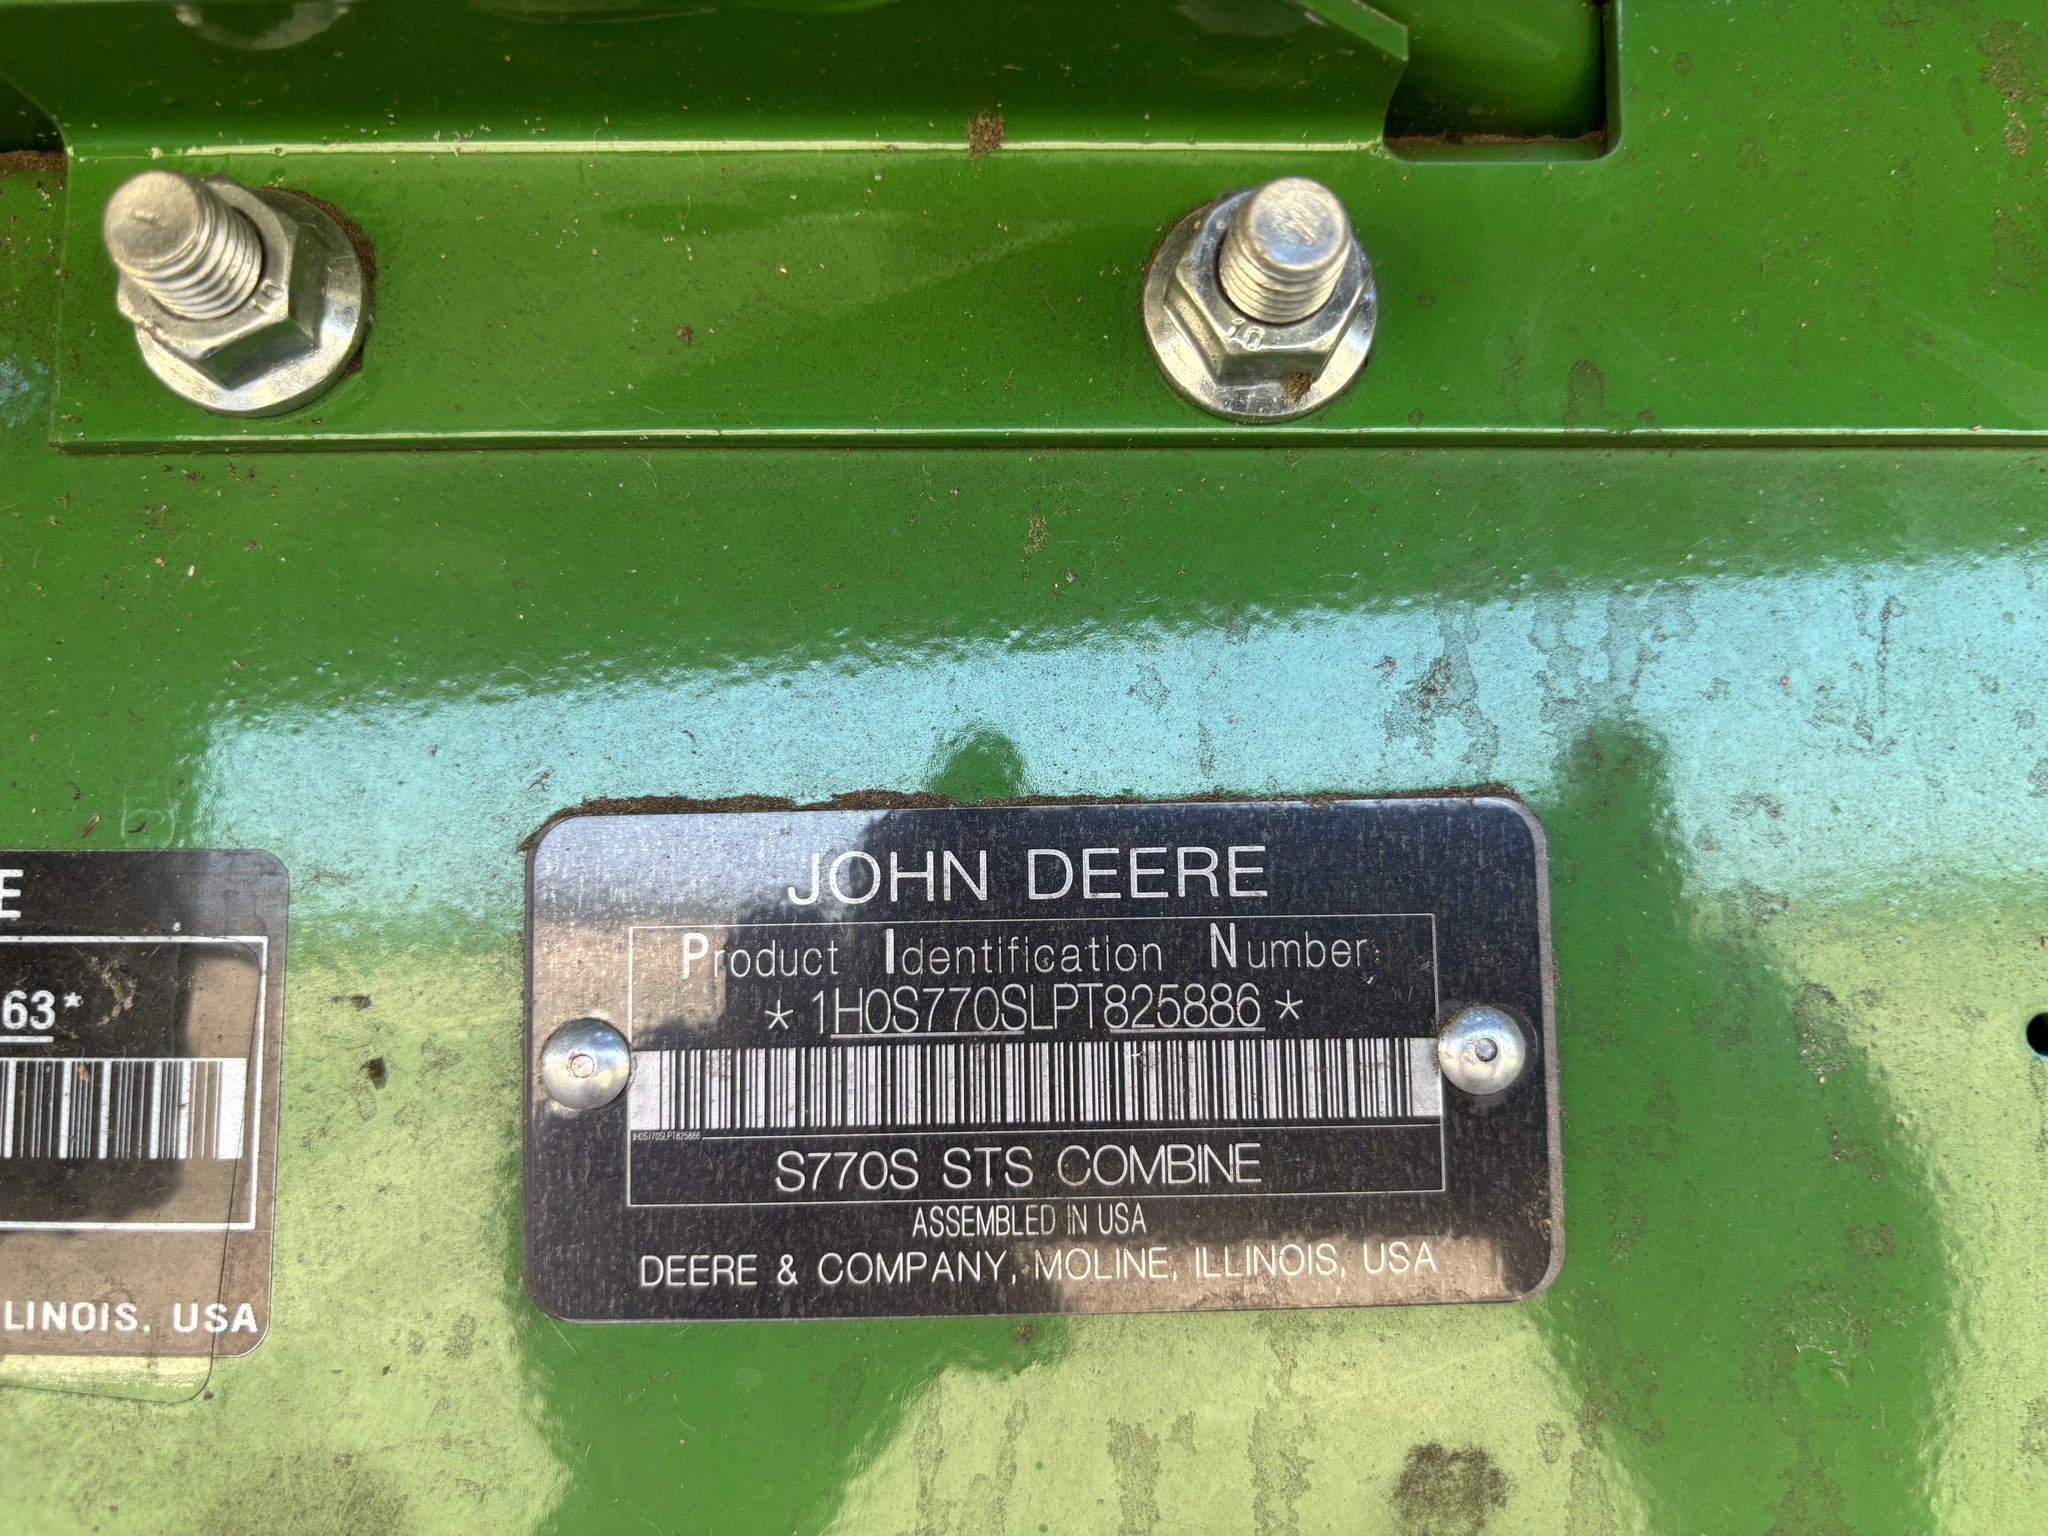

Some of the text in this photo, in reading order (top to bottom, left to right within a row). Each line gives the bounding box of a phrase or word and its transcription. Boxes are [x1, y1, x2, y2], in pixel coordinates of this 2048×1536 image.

[787, 845, 1268, 905] JOHN DEERE
[682, 921, 1368, 980] Product Identification Number
[775, 1142, 1263, 1194] S770S STS COMBINE
[912, 1202, 1148, 1238] ASSEMBLED IN USA
[640, 1240, 1438, 1287] DEERE & COMPANY, MOLINE, ILLINOIS, USA
[172, 1300, 258, 1334] USA
